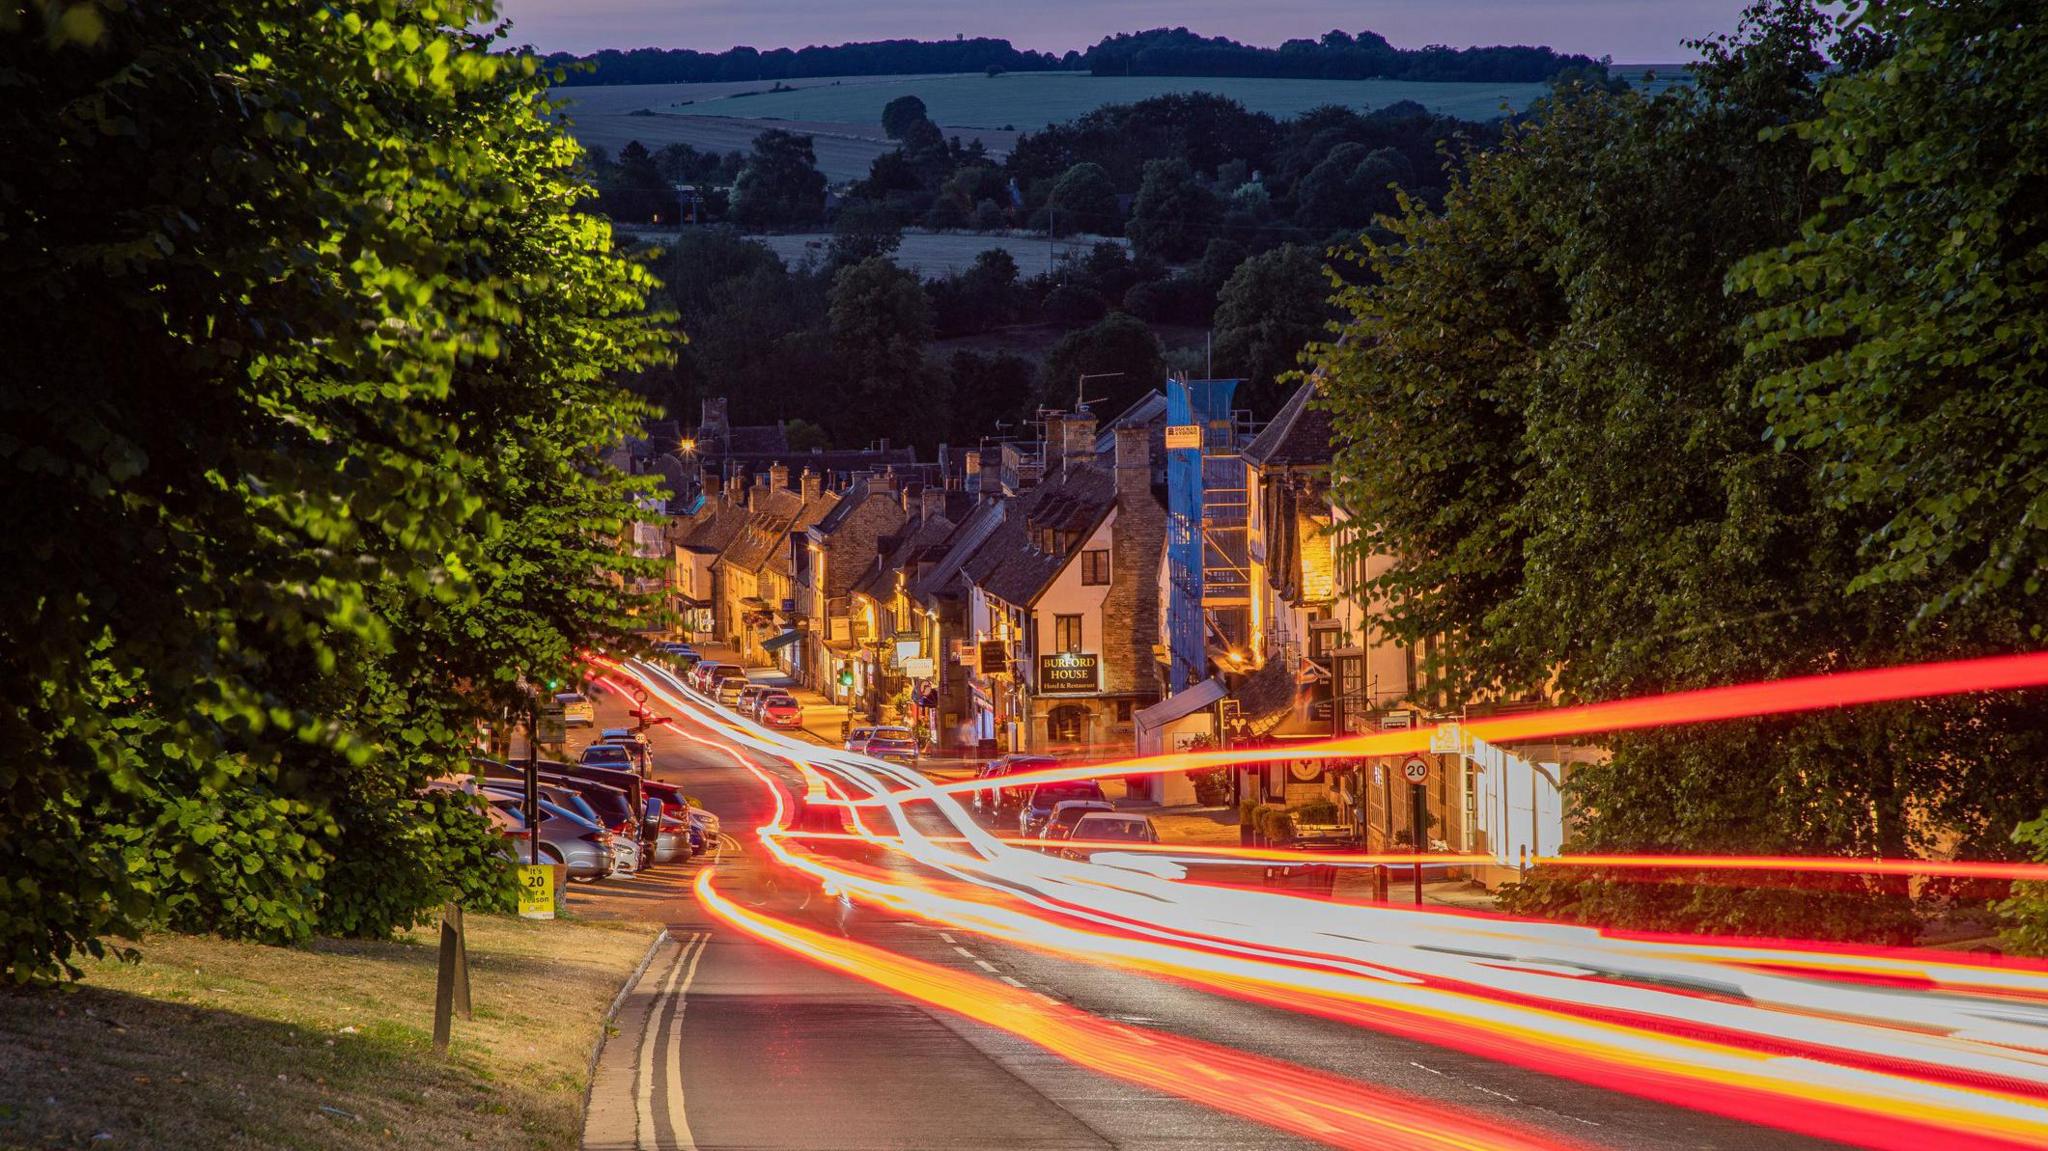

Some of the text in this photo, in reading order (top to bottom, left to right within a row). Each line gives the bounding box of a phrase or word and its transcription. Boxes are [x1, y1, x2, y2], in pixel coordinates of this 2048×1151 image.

[1044, 658, 1095, 668] BURFORD
[1051, 670, 1089, 679] HOUSE
[1407, 765, 1425, 776] 20
[528, 876, 544, 888] 20
